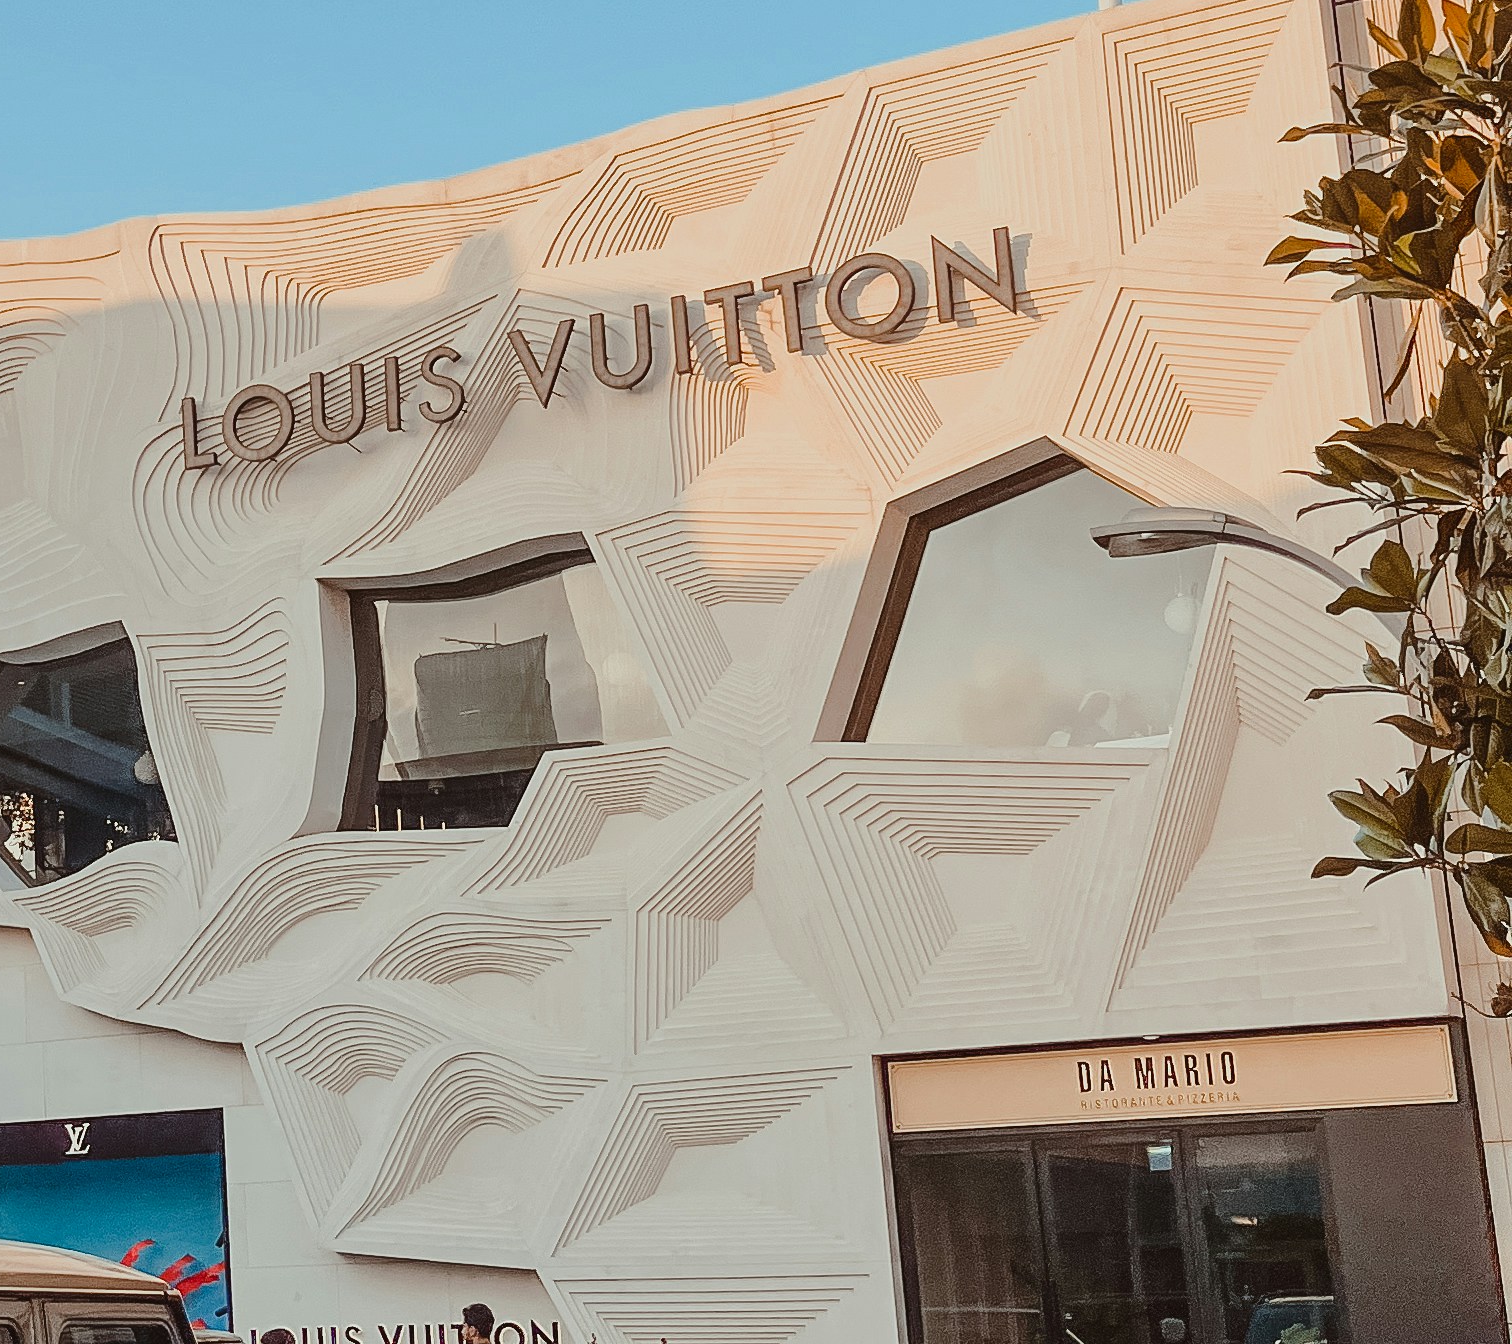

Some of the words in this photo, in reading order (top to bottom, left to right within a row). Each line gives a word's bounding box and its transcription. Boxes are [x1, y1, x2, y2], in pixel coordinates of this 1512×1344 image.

[181, 346, 466, 471] LOUIS
[507, 226, 1018, 409] VUITTON
[1076, 1060, 1115, 1093] DA
[1134, 1051, 1236, 1089] MARIO
[1080, 1095, 1163, 1110] RISTORANTE
[1178, 1091, 1241, 1105] PIZZERIA
